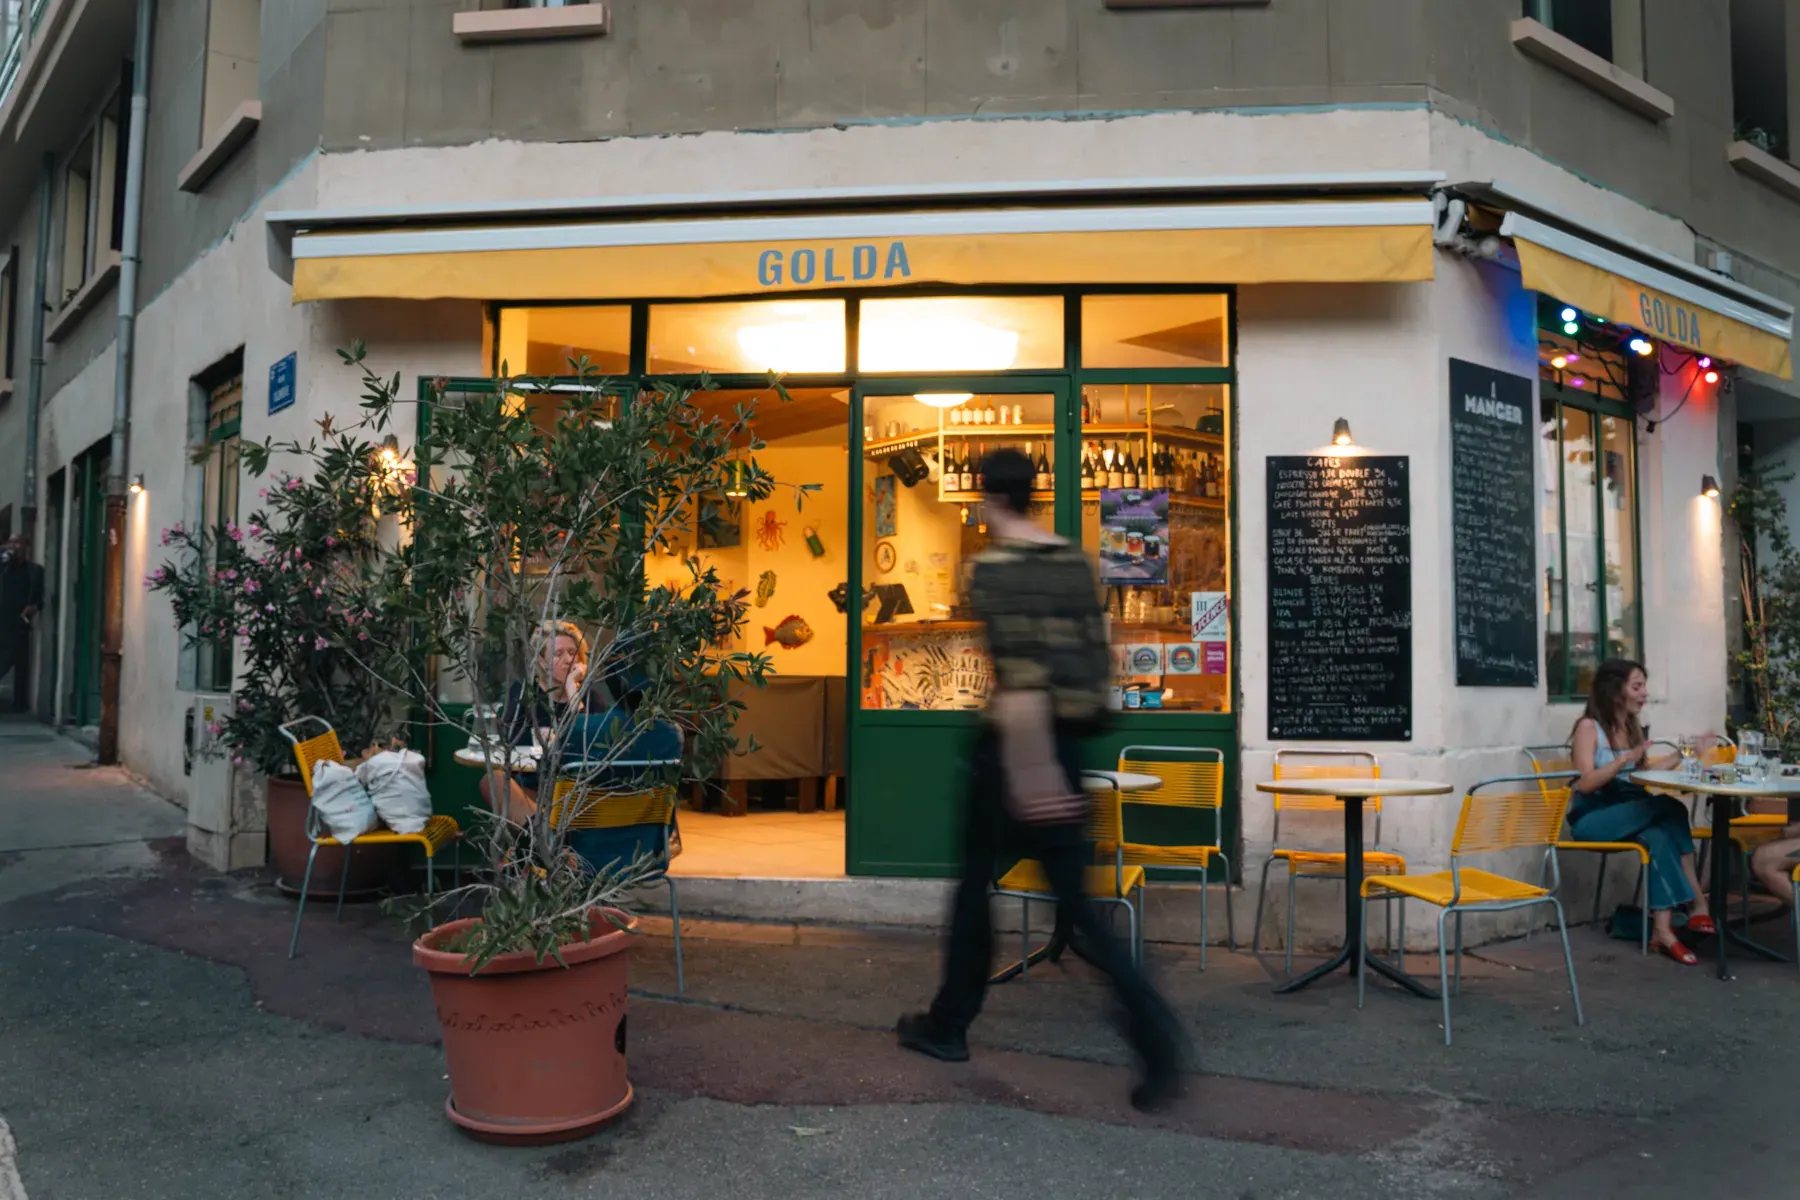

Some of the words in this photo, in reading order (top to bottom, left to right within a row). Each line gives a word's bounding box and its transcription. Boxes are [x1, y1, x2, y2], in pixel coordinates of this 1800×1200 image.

[758, 240, 911, 286] GOLDA
[1639, 292, 1702, 349] GOLDA
[1465, 393, 1523, 425] MANGER
[1279, 469, 1318, 480] ESPRESSO
[1338, 468, 1370, 479] DOUBLE
[1310, 518, 1337, 529] SOFTS
[1192, 594, 1227, 638] LICENCE
[1196, 600, 1207, 611] III
[1275, 609, 1292, 617] IPA
